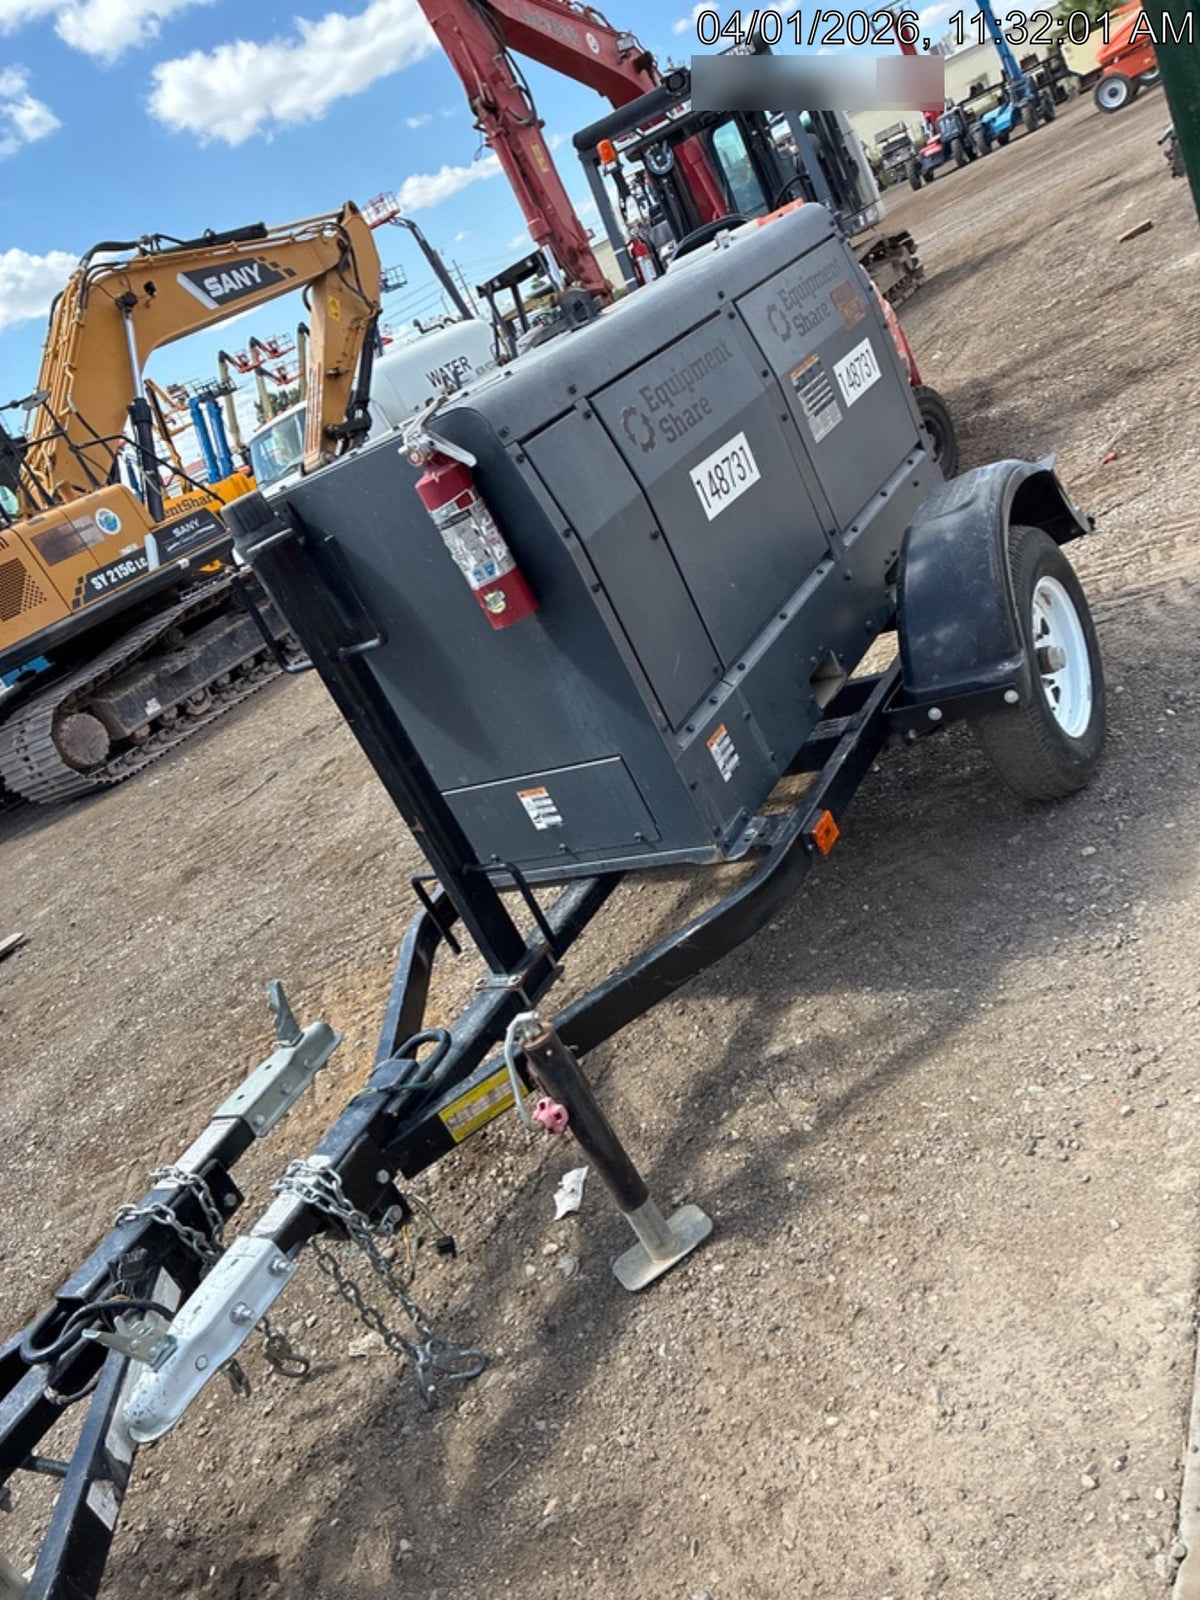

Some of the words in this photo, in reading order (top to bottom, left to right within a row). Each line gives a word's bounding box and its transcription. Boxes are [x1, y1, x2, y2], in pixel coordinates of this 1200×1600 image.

[203, 262, 262, 298] SANY
[777, 258, 843, 310] Equipment
[792, 301, 831, 337] Share
[425, 355, 472, 388] WATER
[638, 340, 733, 413] Equipment
[838, 349, 877, 397] 148731
[658, 396, 713, 444] Share
[696, 445, 754, 509] 148731
